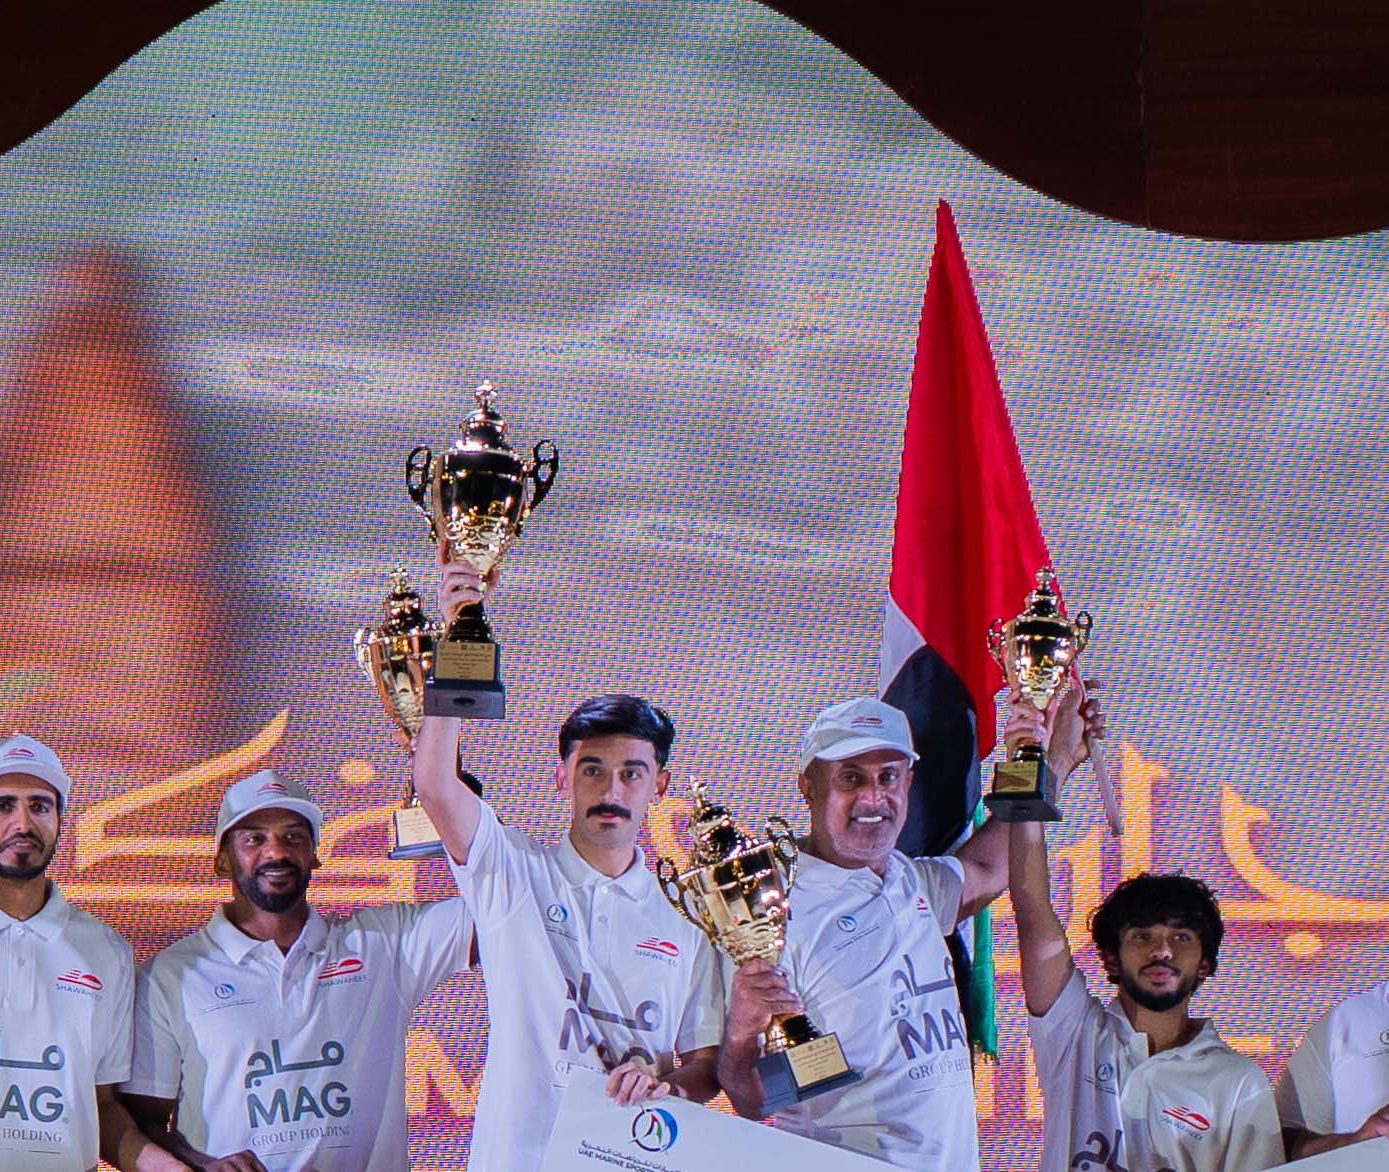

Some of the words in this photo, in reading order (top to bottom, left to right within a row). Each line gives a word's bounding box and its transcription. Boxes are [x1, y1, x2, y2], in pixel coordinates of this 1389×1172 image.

[897, 1008, 966, 1060] MA
[245, 1081, 352, 1128] MAG
[2, 1128, 62, 1143] HOLDING
[251, 1131, 298, 1147] GROUP
